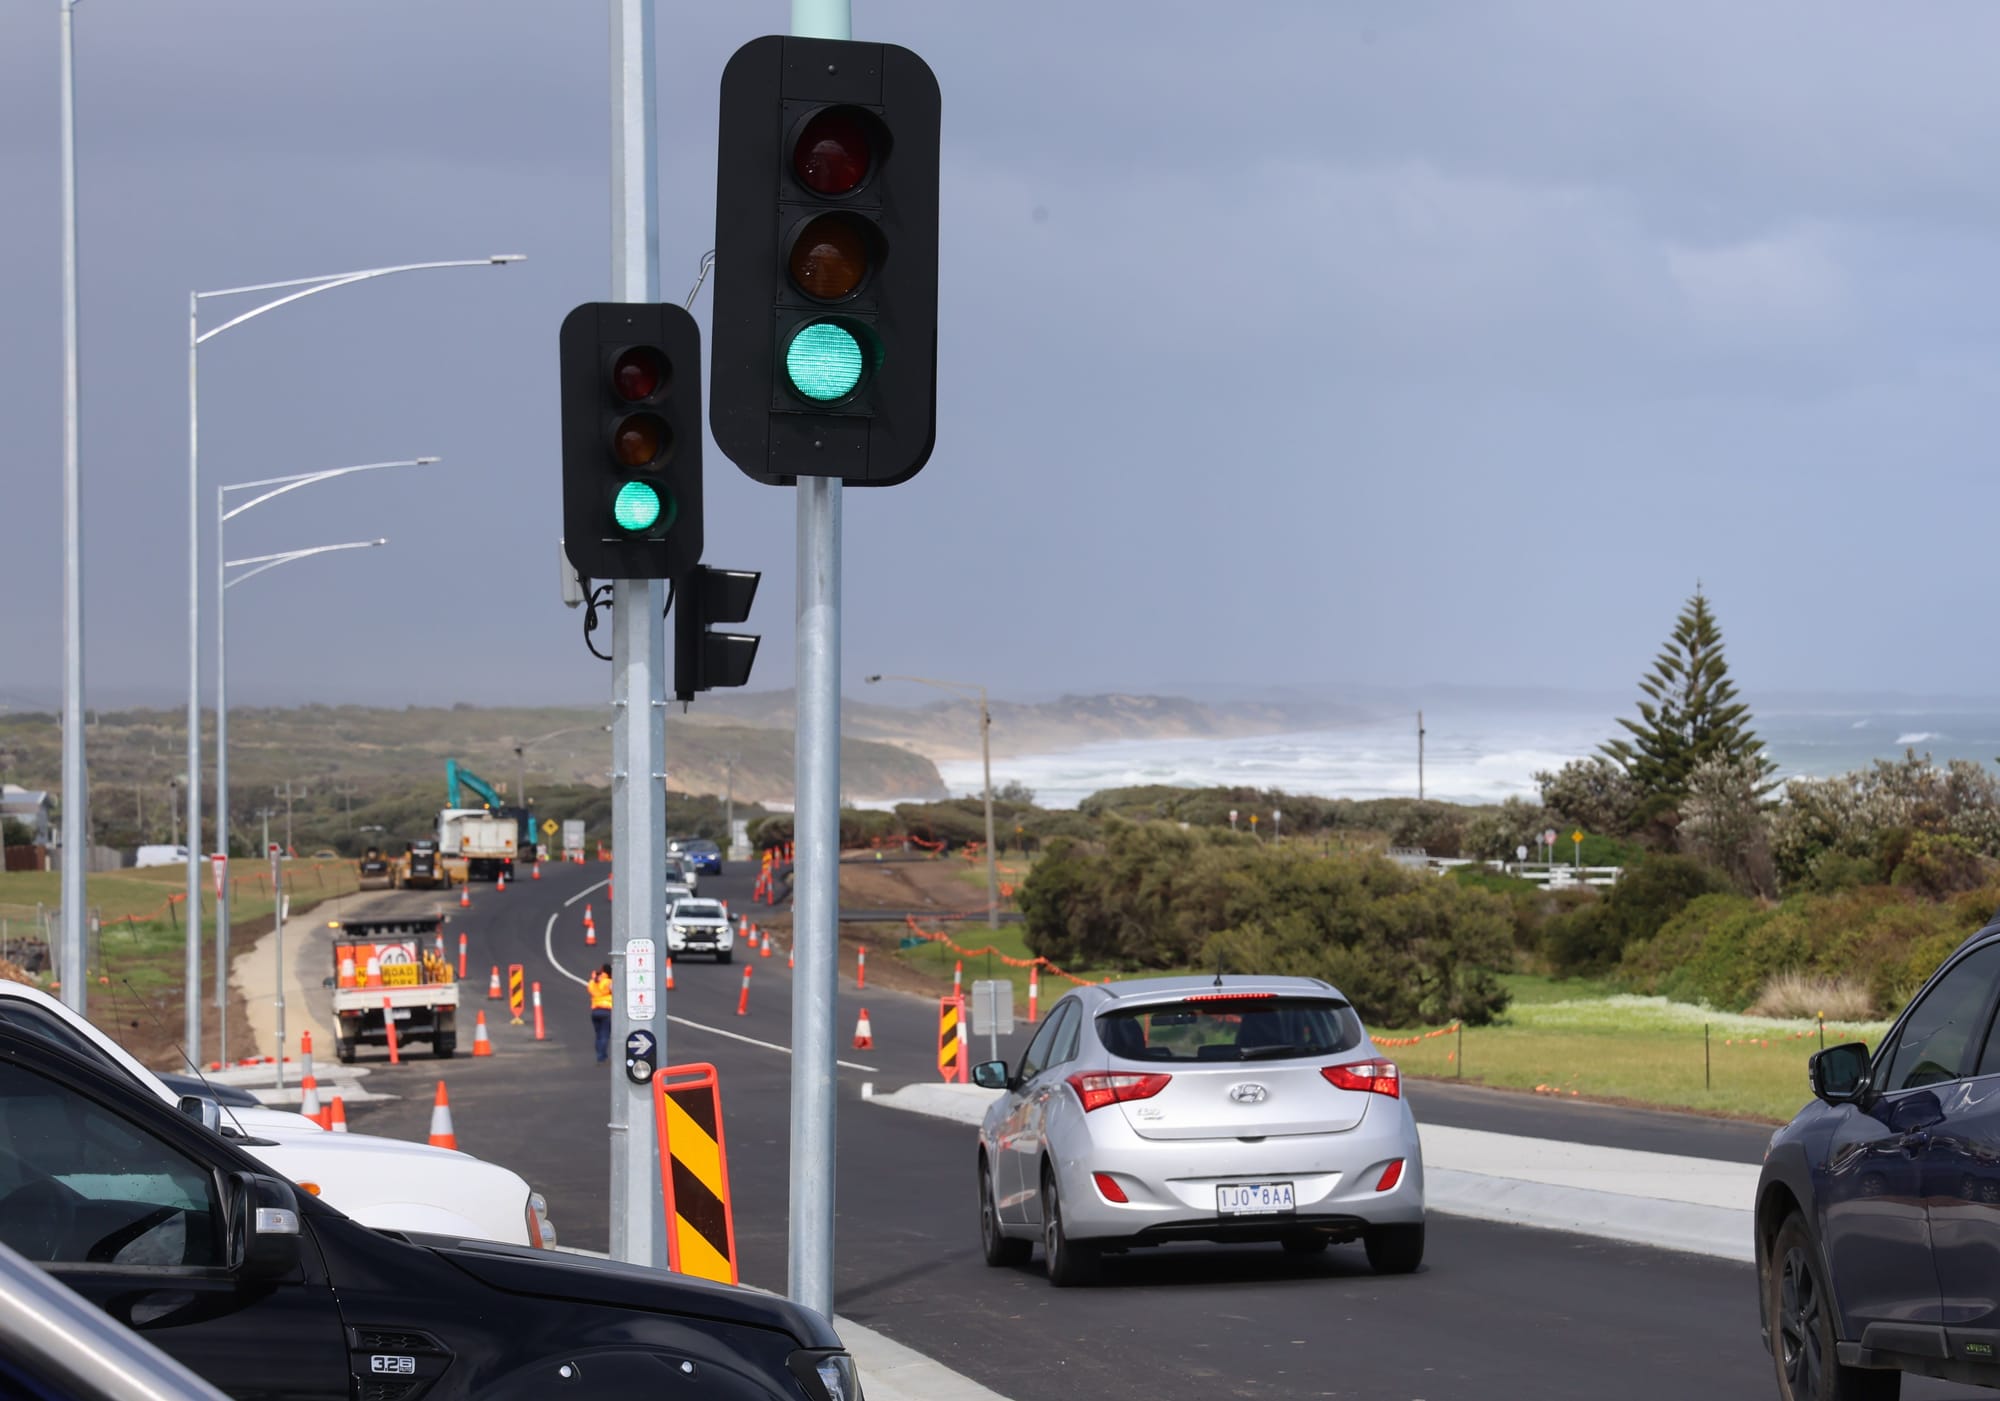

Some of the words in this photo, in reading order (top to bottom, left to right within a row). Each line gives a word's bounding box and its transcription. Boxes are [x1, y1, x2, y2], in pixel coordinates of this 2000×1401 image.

[383, 967, 413, 977] ROAD
[1262, 1188, 1293, 1205] 8AA
[373, 1356, 399, 1372] 3.2
